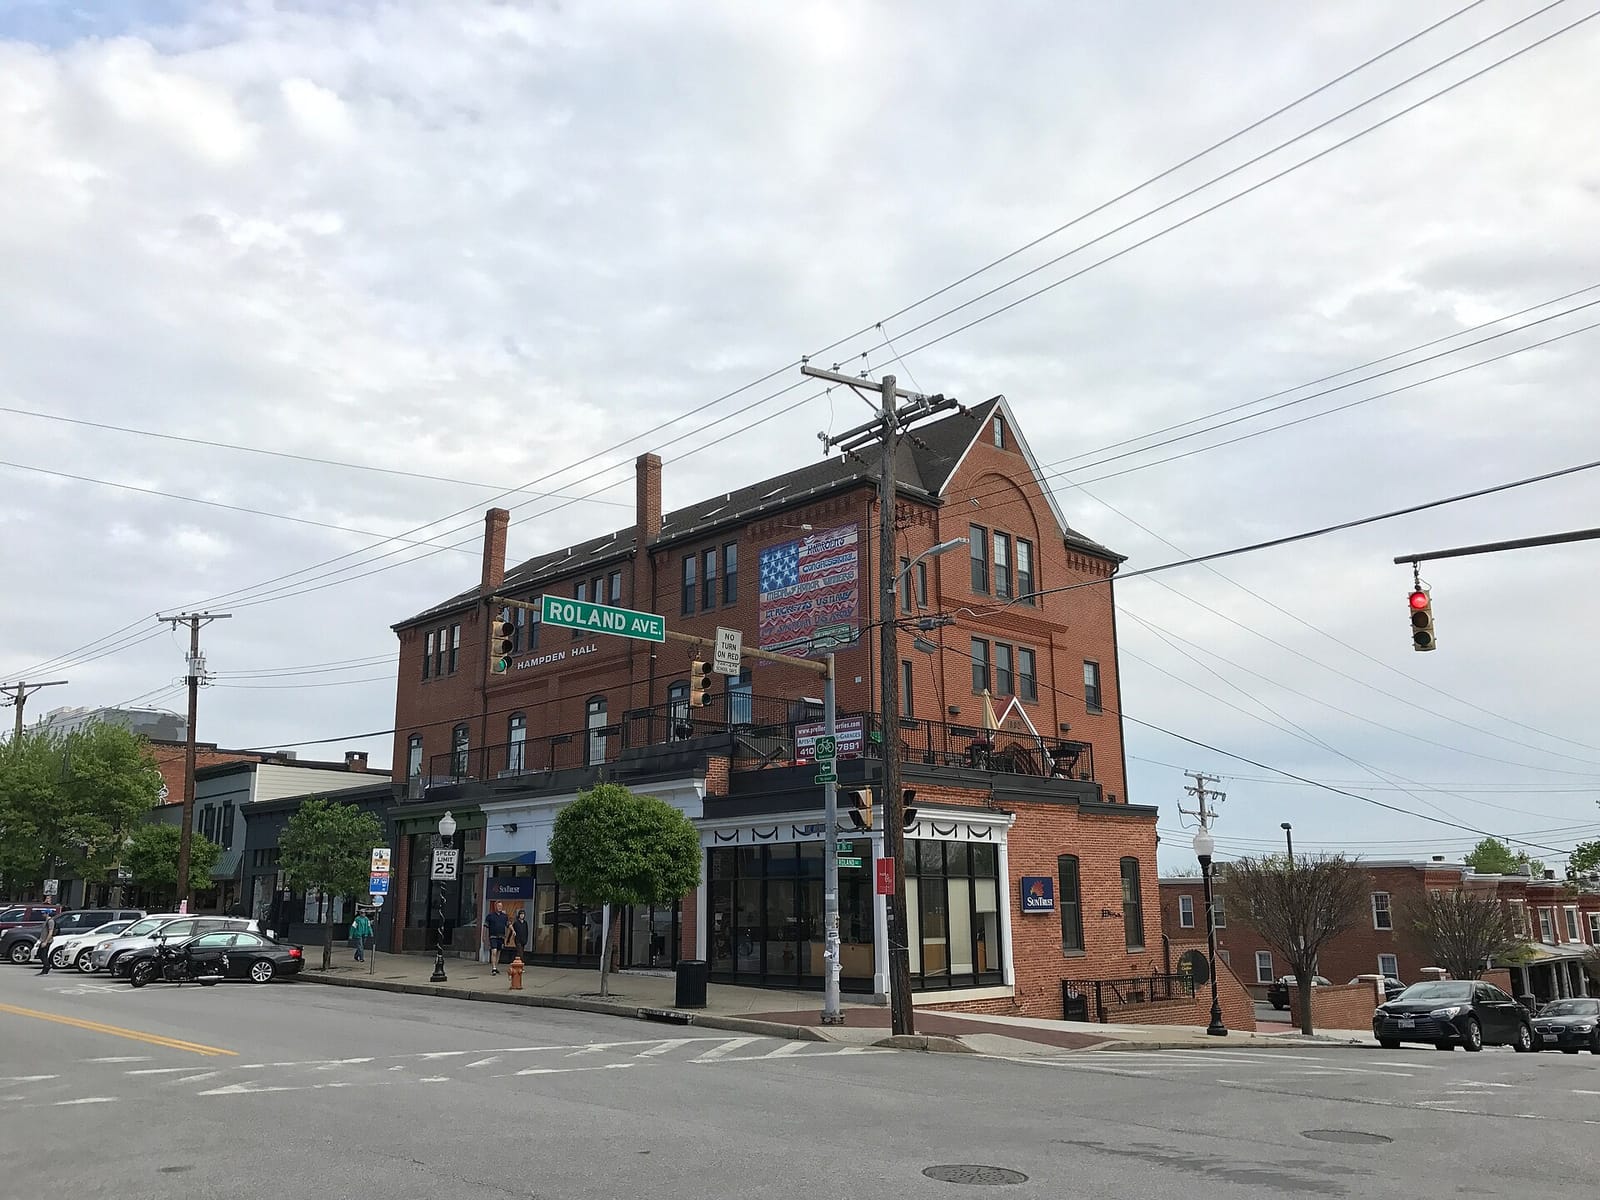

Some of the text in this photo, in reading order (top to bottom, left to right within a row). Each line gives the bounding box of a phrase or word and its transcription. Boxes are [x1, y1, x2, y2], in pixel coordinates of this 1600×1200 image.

[803, 553, 856, 572] CONGRESSIONAL
[797, 581, 820, 593] HONOR
[549, 601, 662, 635] ROLAND AVE.
[724, 633, 735, 641] NO
[721, 642, 737, 651] TURN
[516, 643, 598, 670] HAMPDEN HALL
[717, 650, 739, 661] ON RED
[434, 862, 455, 874] 25
